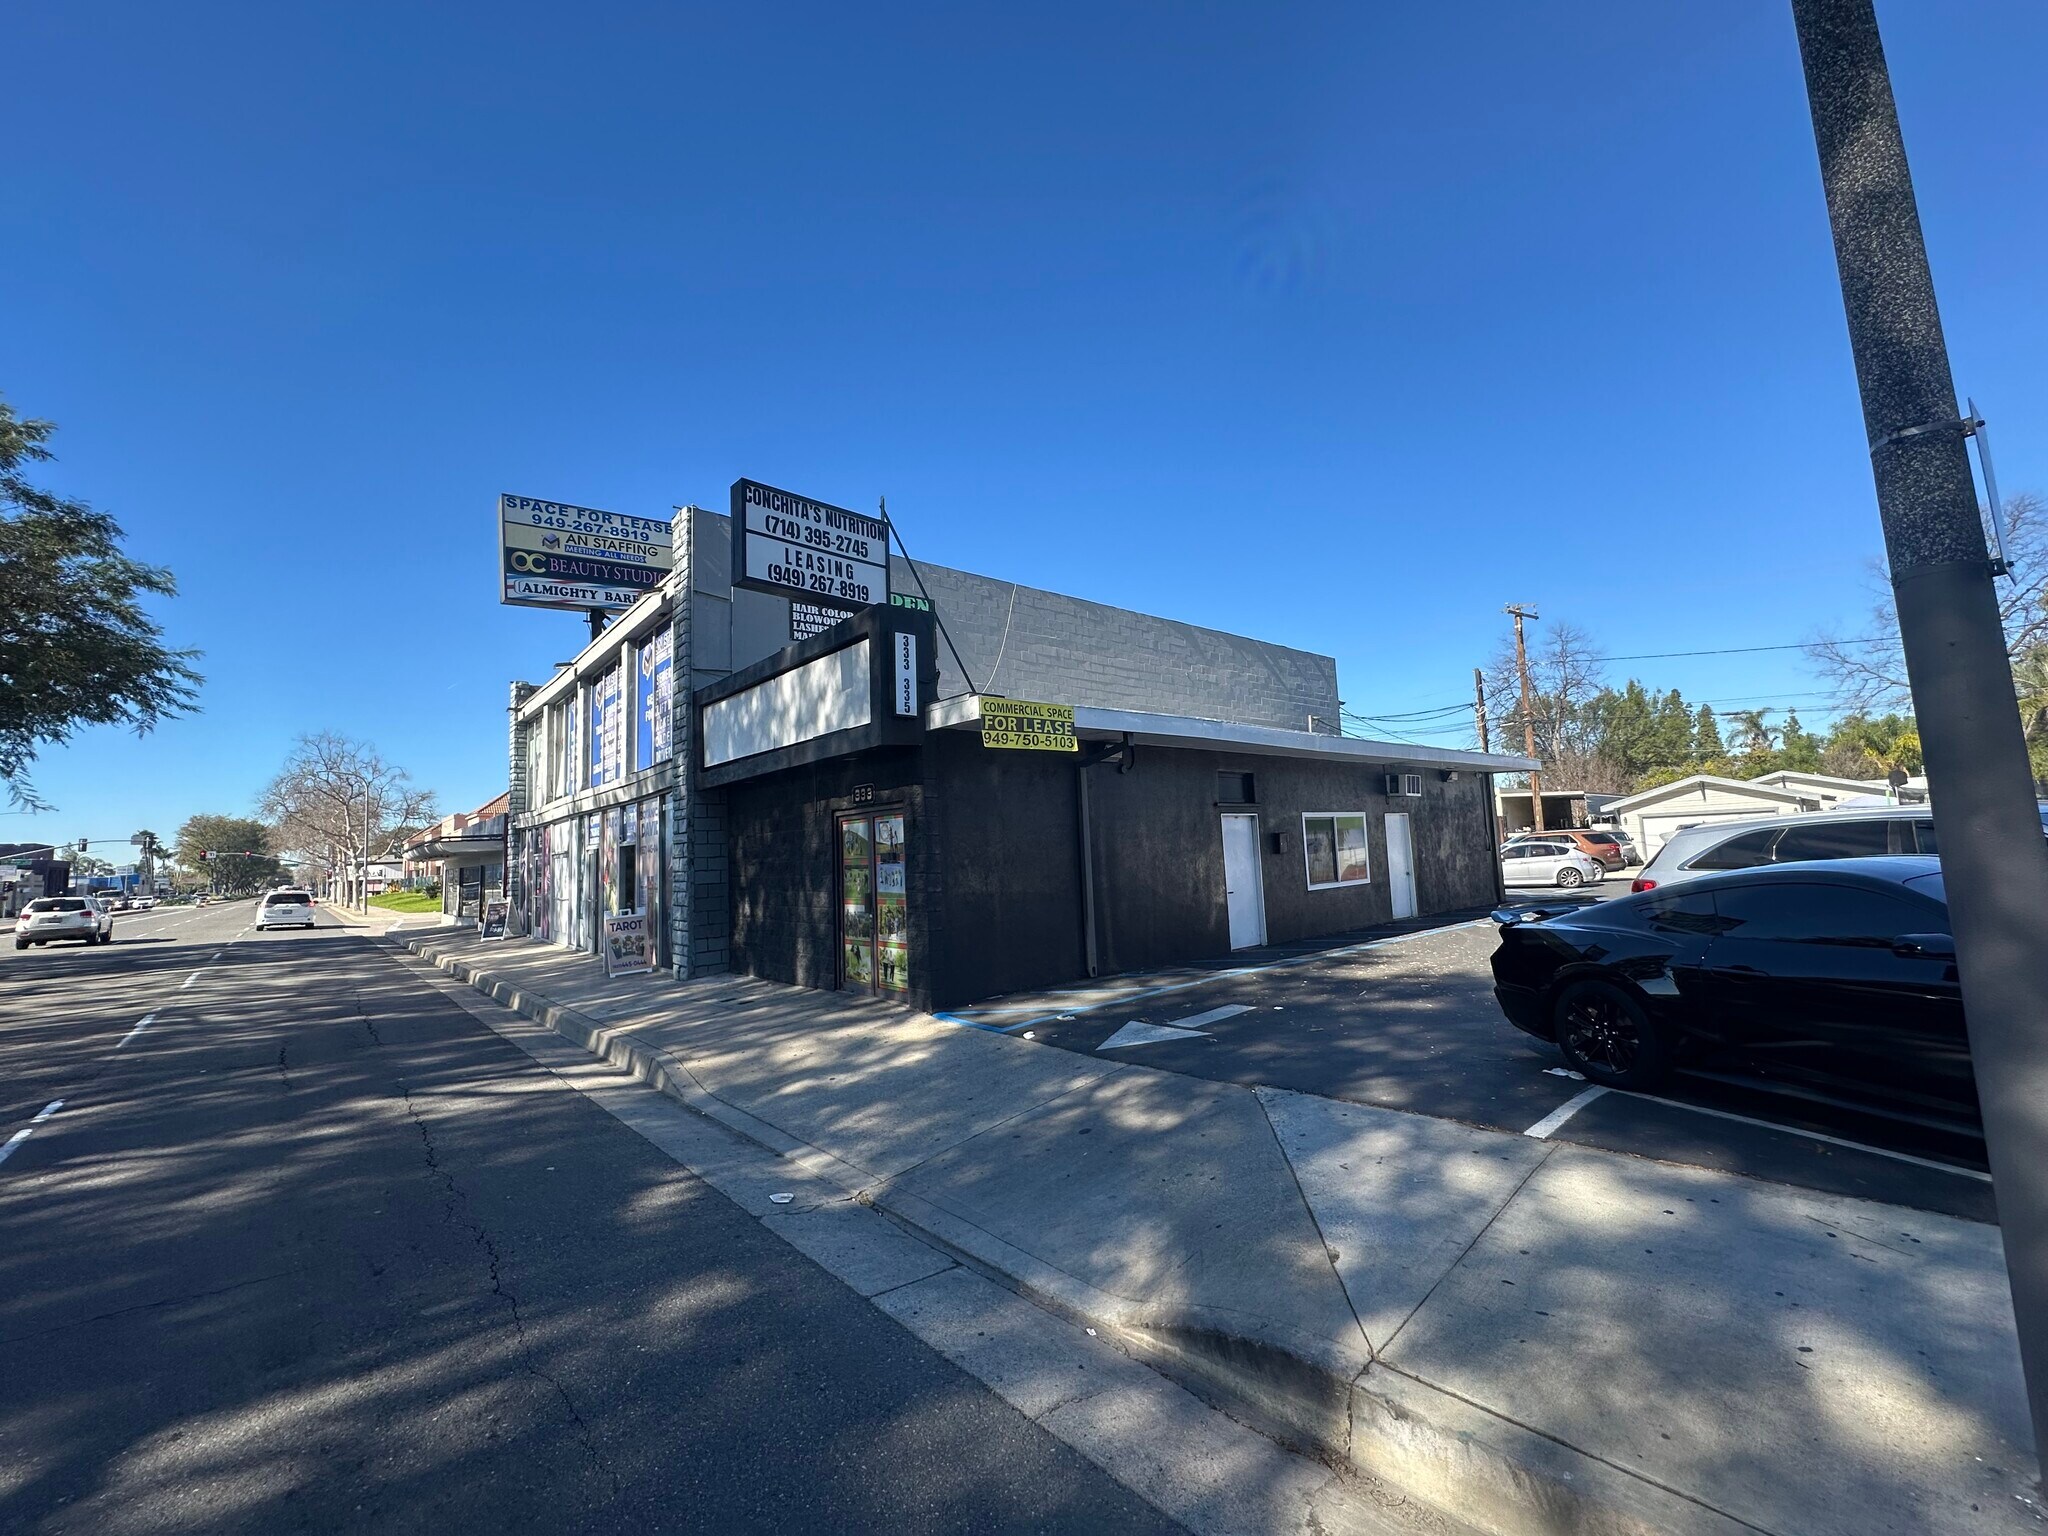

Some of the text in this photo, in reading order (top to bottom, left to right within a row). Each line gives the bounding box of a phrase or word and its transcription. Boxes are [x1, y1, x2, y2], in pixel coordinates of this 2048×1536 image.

[506, 497, 672, 535] SPACE FOR LEASE
[746, 486, 885, 542] CONCHITA'S NUTRITION
[531, 514, 649, 542] 949-267-8919
[765, 514, 869, 558] (714) 395-2745
[565, 534, 658, 557] AN STAFFING
[565, 546, 645, 563] MEETING ALL NEEDS
[511, 551, 547, 574] OC
[549, 557, 613, 578] BEAUTY
[784, 547, 854, 580] LEASING
[522, 582, 598, 600] ALMIGHTY
[767, 563, 869, 602] (949) 267-8919
[792, 602, 819, 615] HAIR
[983, 701, 1073, 719] COMMERCIAL SPACE
[984, 715, 1073, 735] FOR LEASE
[983, 731, 1074, 749] 949-750-5103
[609, 919, 643, 932] TAROT
